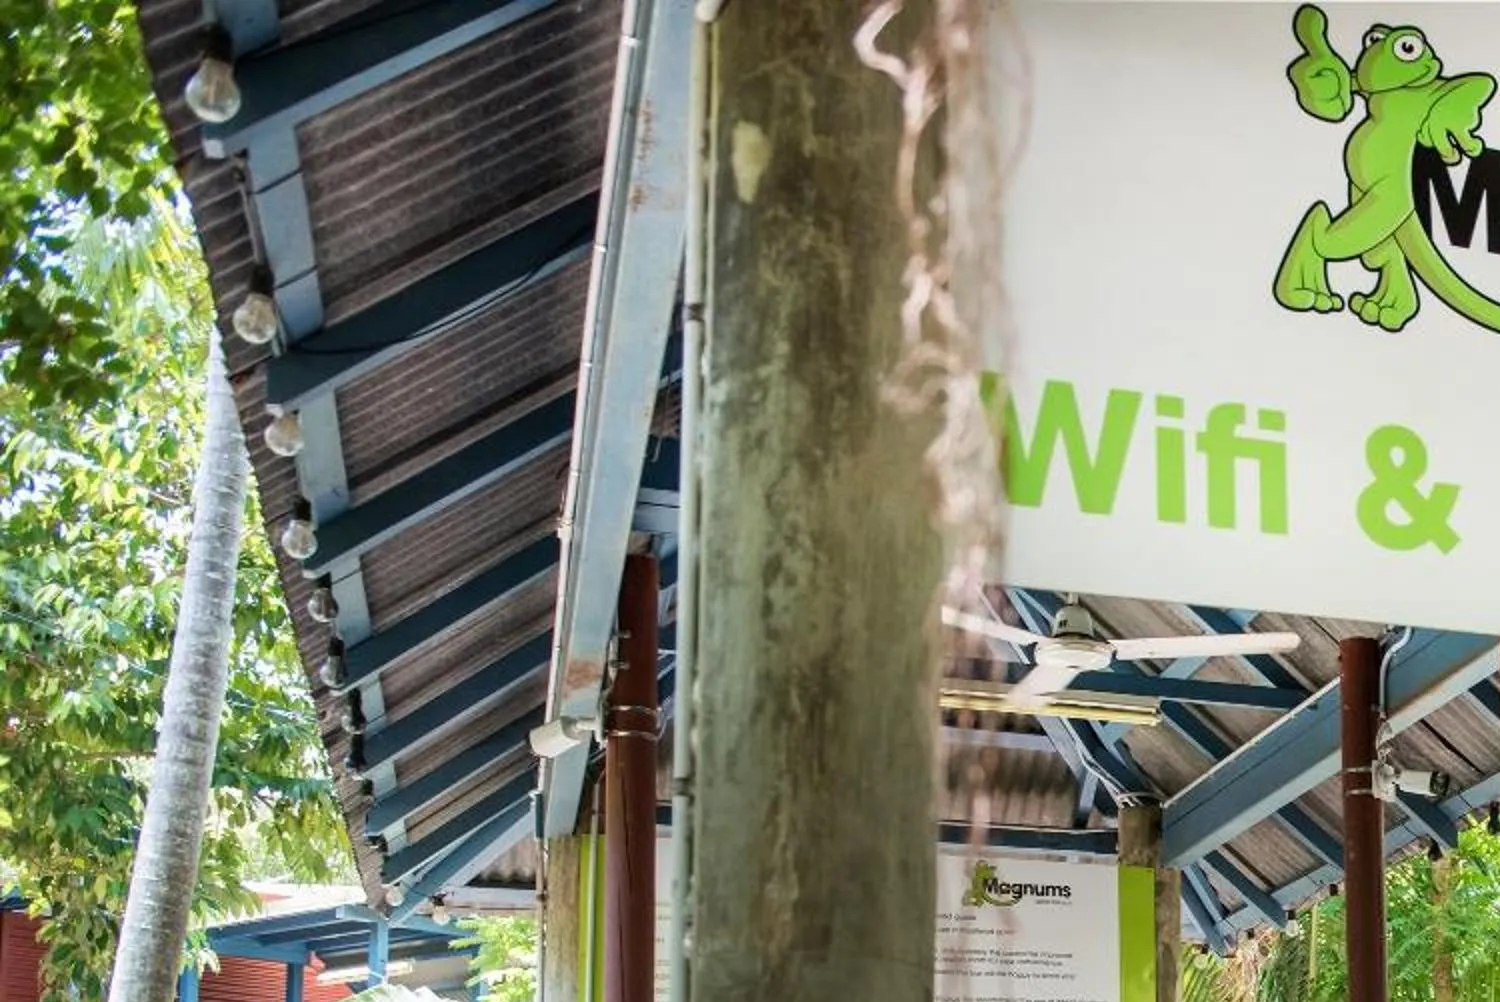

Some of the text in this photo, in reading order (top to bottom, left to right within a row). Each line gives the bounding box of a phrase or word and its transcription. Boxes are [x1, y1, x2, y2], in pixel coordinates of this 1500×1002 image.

[979, 370, 1289, 536] Wifi
[1355, 423, 1462, 557] &
[983, 877, 1072, 899] Magnums
